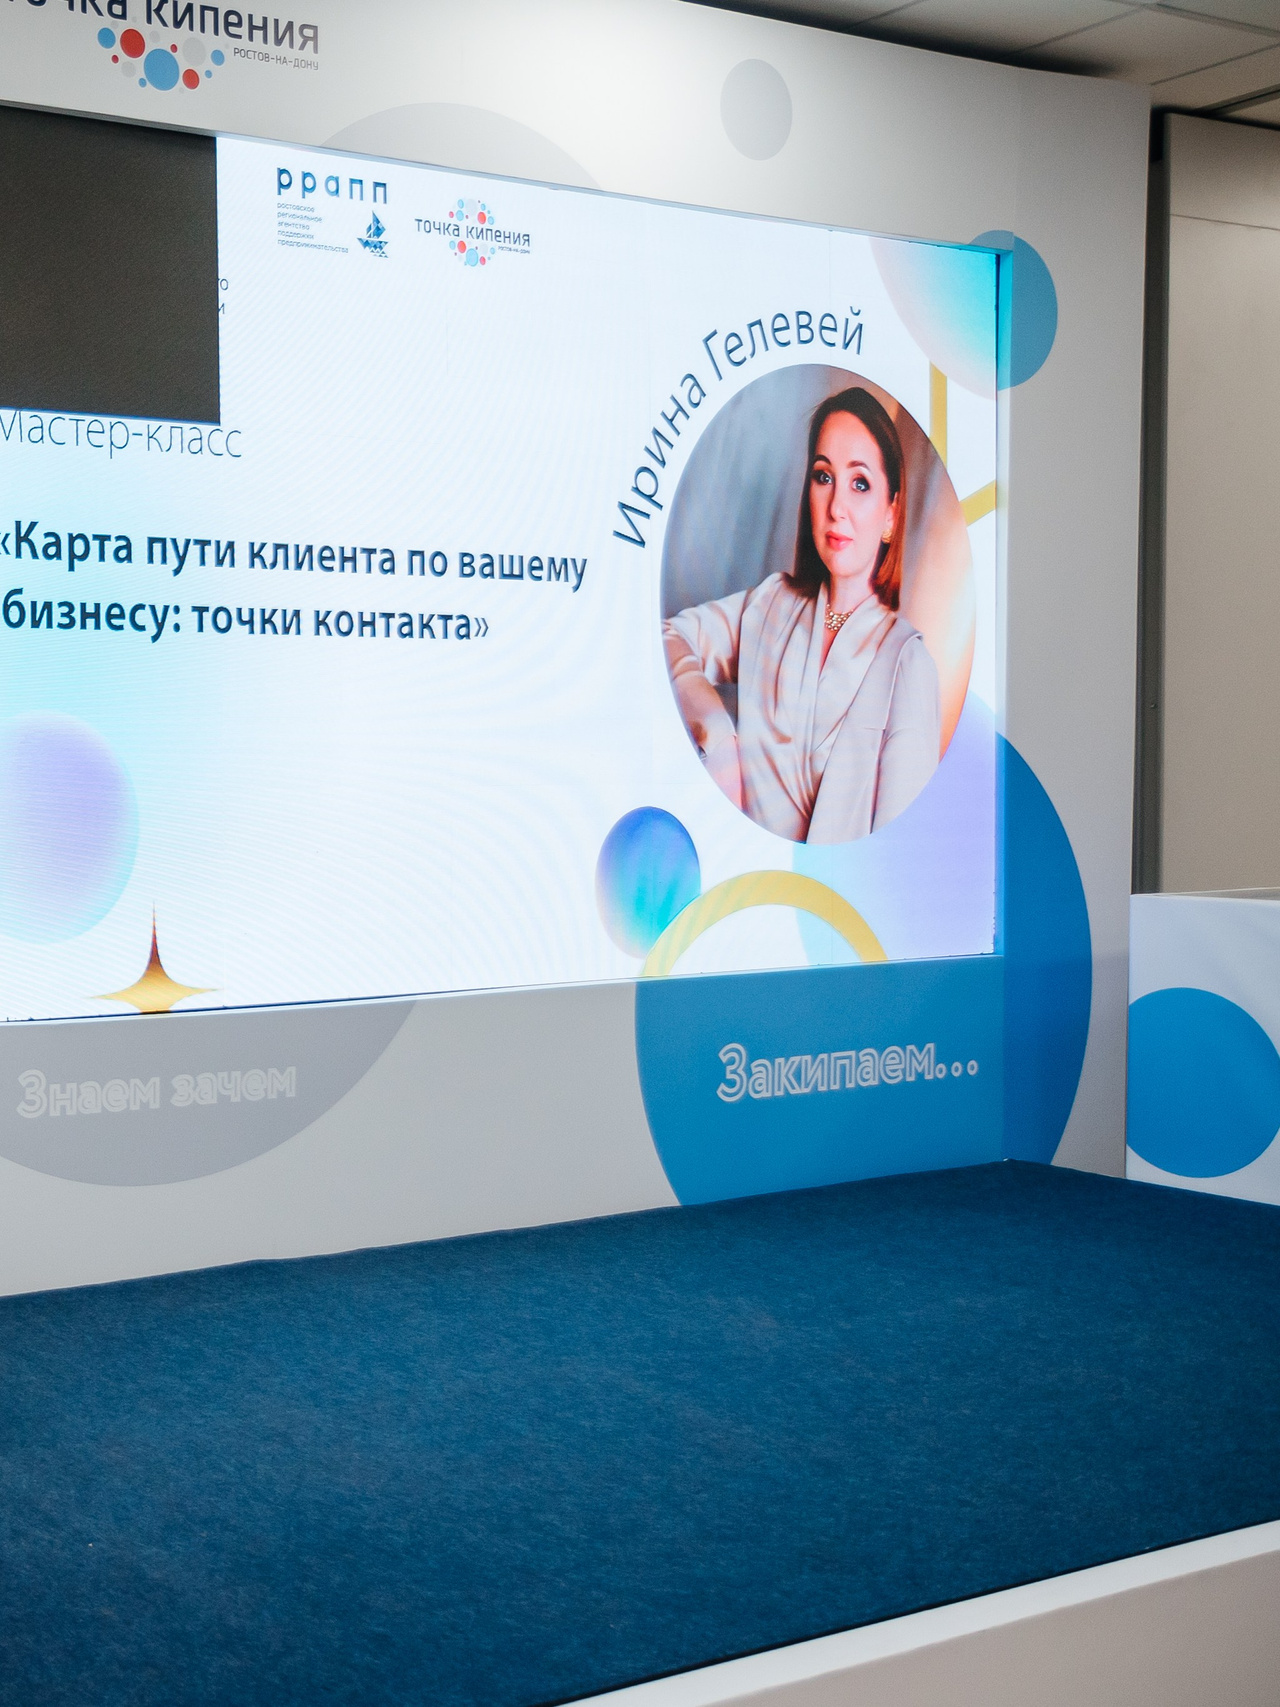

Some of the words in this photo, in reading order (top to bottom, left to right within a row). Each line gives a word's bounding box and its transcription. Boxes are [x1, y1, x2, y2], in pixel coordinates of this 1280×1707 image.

[146, 0, 319, 55] кипения
[233, 47, 319, 71] РОСТОВ-НА-ДОНУ
[276, 167, 388, 205] ррапп
[414, 218, 461, 238] точка
[465, 225, 531, 248] кипения
[612, 373, 708, 549] Ирина
[701, 305, 865, 382] Гелевей
[146, 535, 236, 577] пути
[247, 540, 397, 576] клиента
[406, 549, 449, 578] по
[457, 551, 588, 594] вашему
[1, 587, 182, 645] бизнесу:
[190, 604, 302, 636] точки
[313, 608, 490, 641] контакта»
[16, 1068, 161, 1119] Знаем
[170, 1065, 298, 1108] зачем
[715, 1042, 980, 1103] Закипаем...
